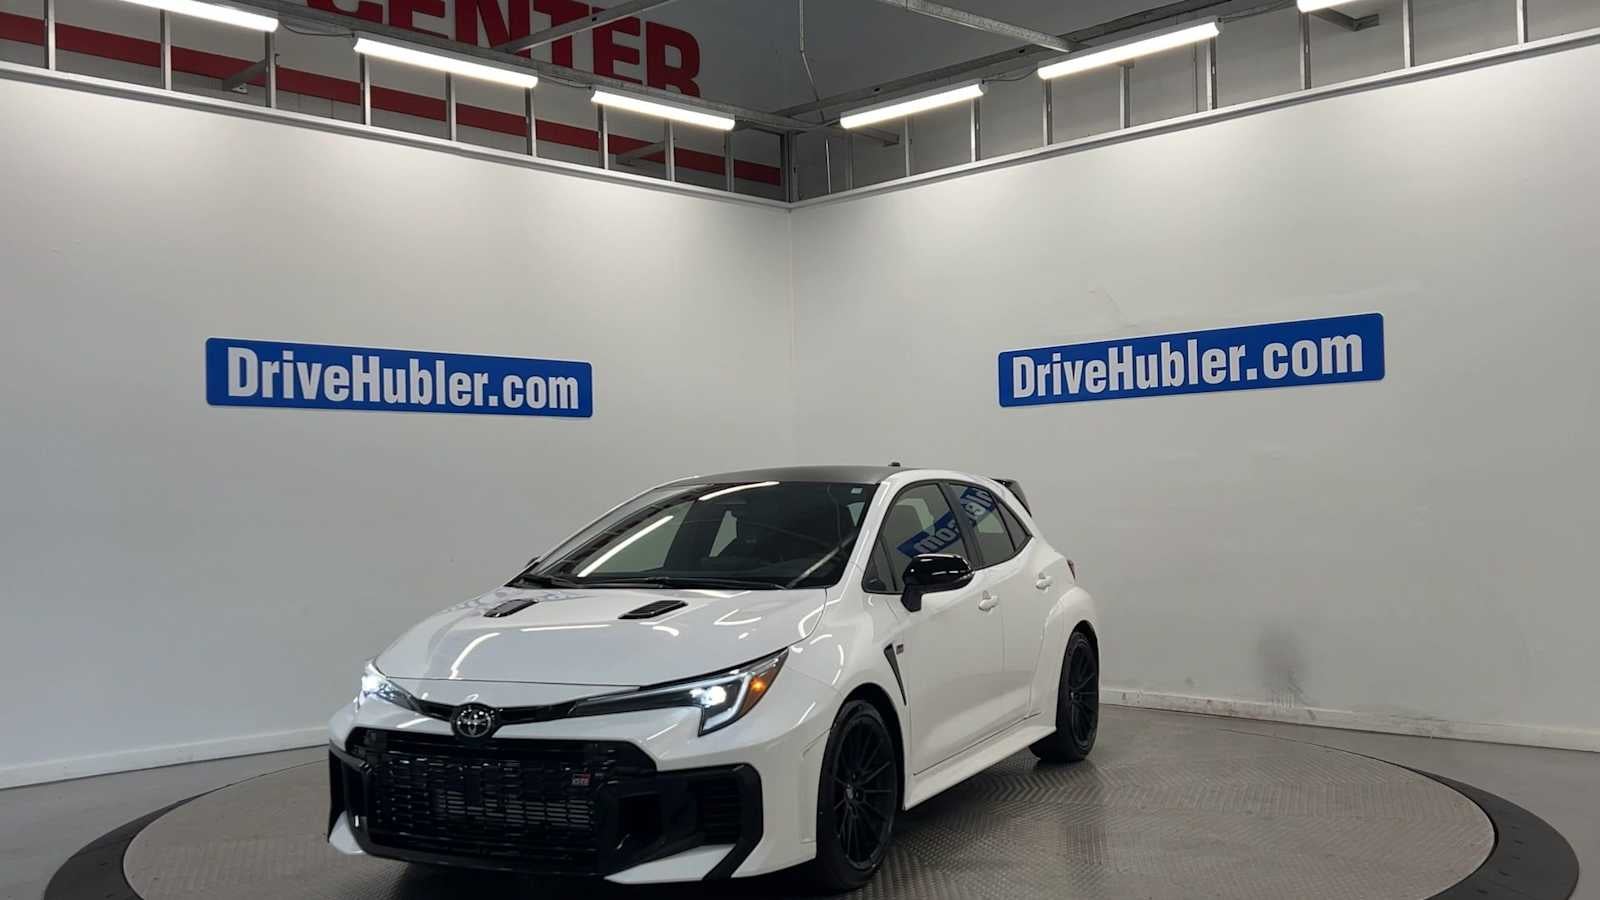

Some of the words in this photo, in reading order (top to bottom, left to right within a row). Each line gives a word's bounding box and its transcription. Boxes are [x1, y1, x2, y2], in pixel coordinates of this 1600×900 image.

[305, 0, 701, 98] NTER
[227, 347, 579, 409] DriveHubler.com
[1012, 333, 1363, 399] DriveHubler.com
